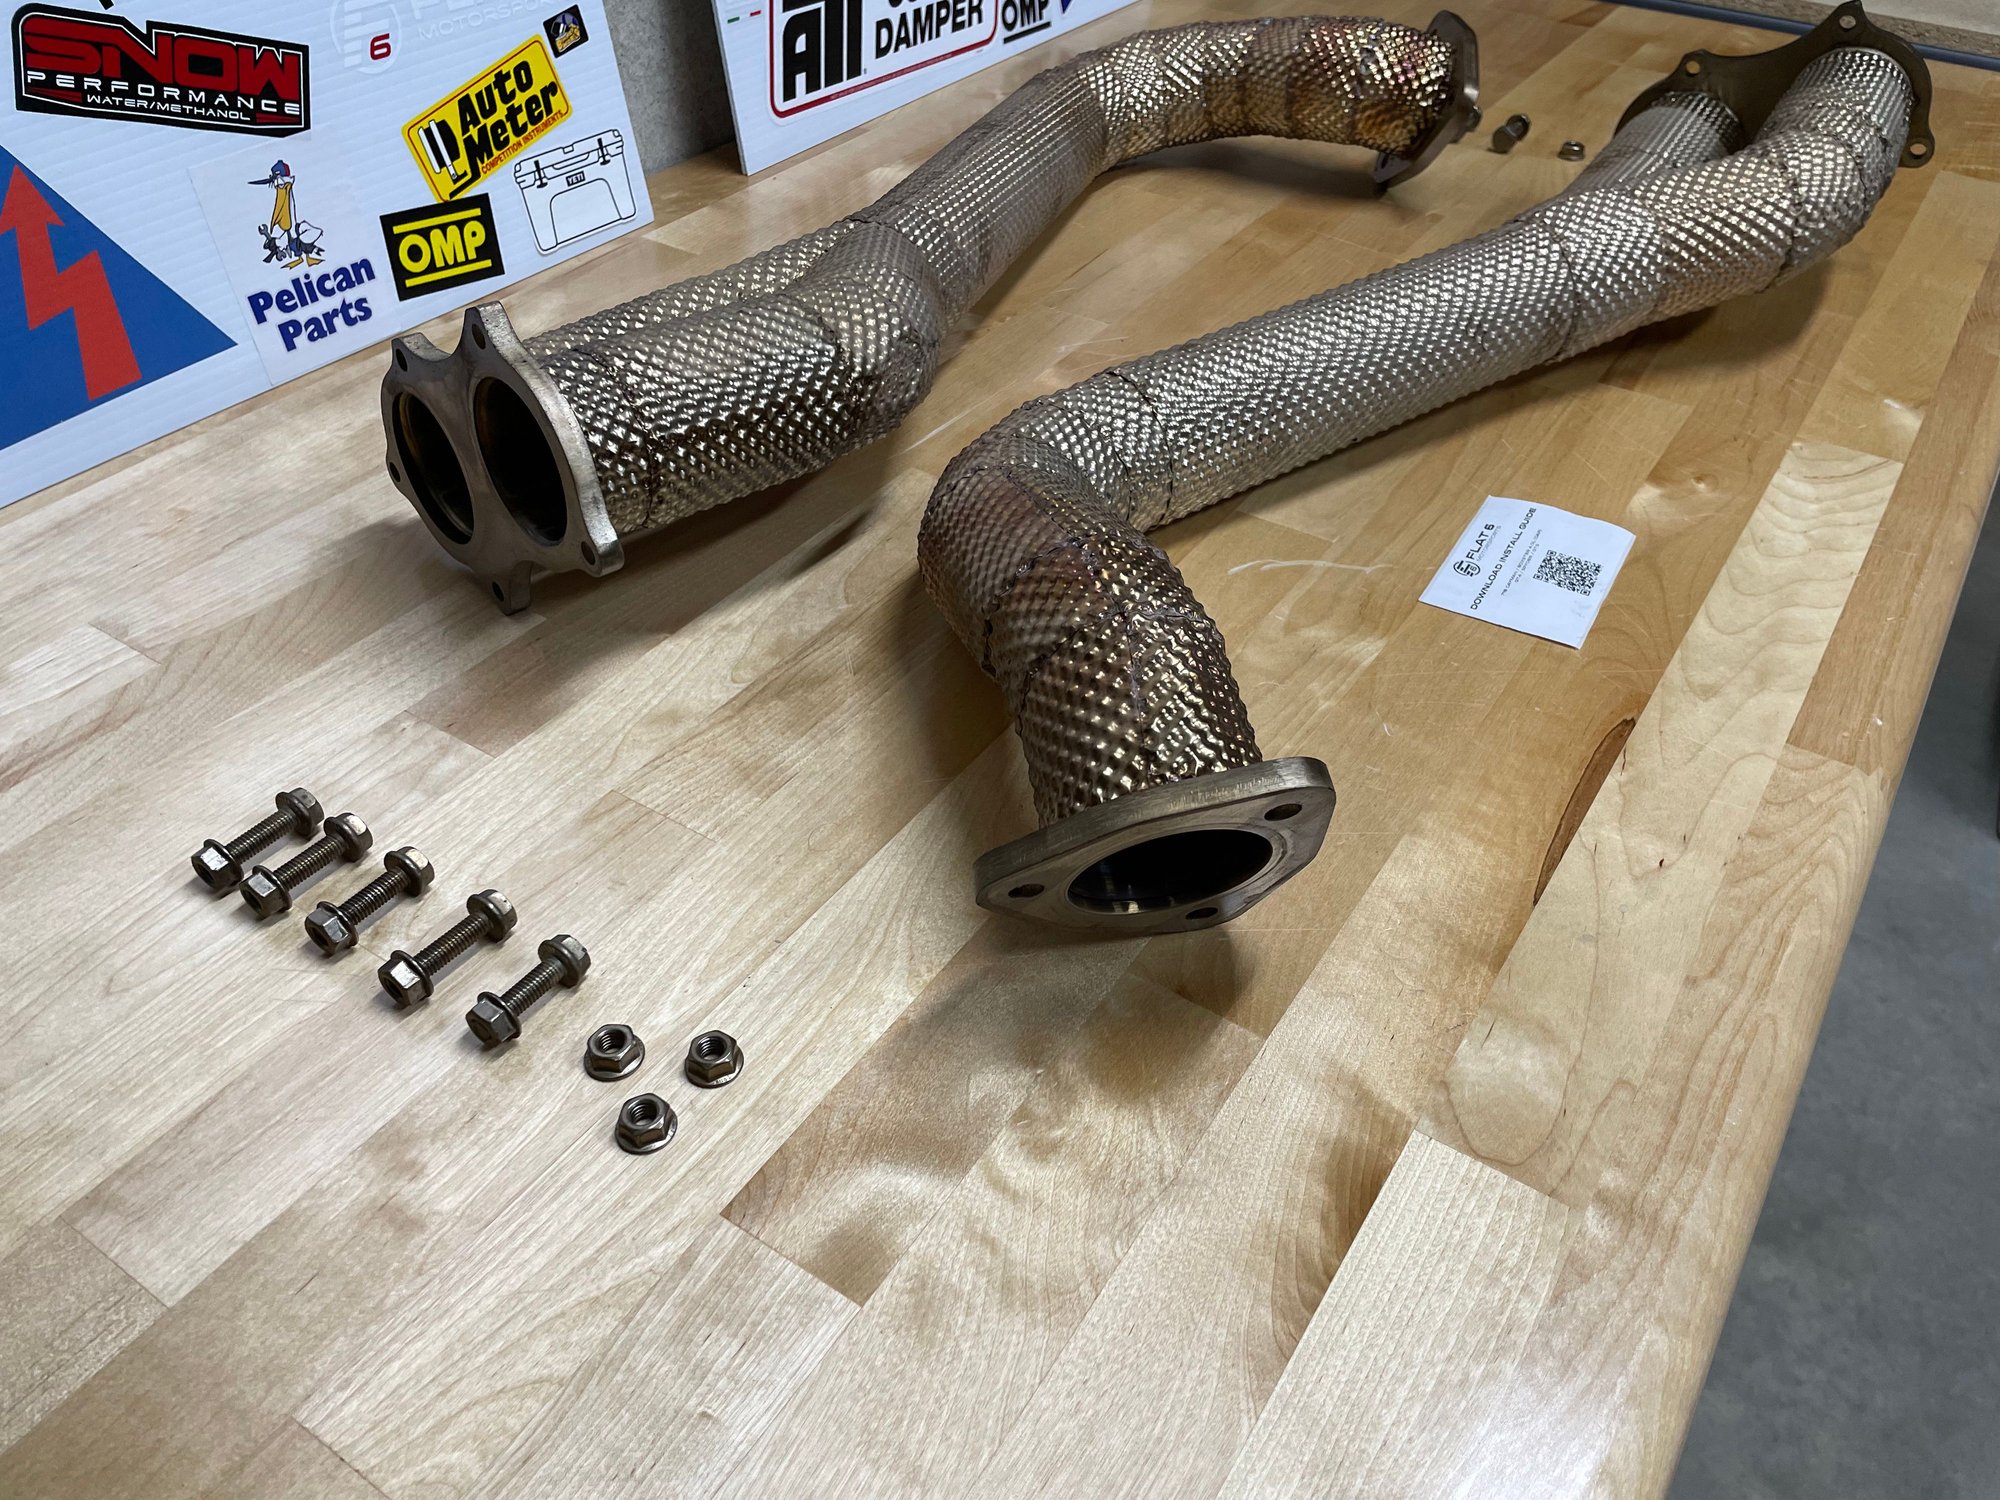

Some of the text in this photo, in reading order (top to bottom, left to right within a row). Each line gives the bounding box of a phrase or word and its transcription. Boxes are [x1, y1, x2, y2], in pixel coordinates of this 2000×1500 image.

[875, 0, 983, 59] DAMPER
[1002, 0, 1051, 31] OMP
[22, 16, 300, 100] SNOW
[369, 33, 392, 60] 6
[27, 70, 300, 115] PERFORMANCE
[87, 94, 250, 121] WATER/METHANOL
[457, 61, 534, 136] Auto
[456, 81, 558, 182] Meter
[482, 110, 564, 174] COMPETITION INSTRUMENTS
[567, 172, 584, 184] YETI
[398, 220, 486, 273] OMP
[248, 258, 376, 324] Pelican
[278, 297, 373, 352] Parts
[1465, 531, 1489, 560] FLAT
[1470, 563, 1502, 610] DOWNLOAD
[1499, 531, 1523, 563] INSTALL
[1519, 507, 1537, 530] GUIDE
